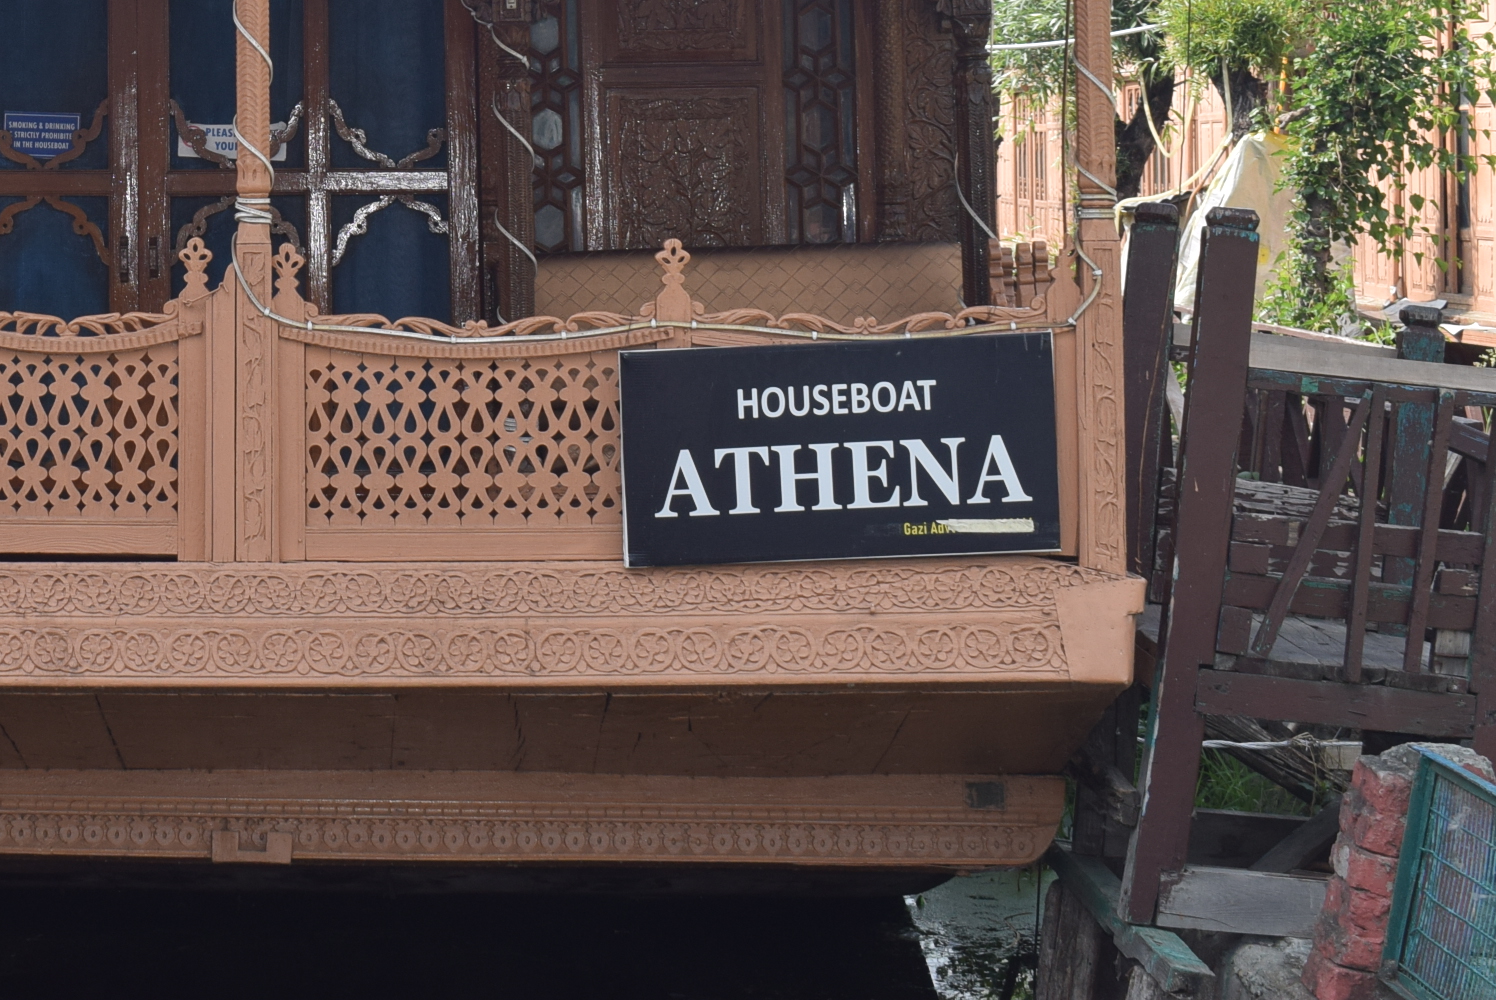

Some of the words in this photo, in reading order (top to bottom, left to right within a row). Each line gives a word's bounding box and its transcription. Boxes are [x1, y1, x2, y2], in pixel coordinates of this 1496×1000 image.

[8, 121, 38, 130] SMOKING
[45, 123, 76, 131] DRINKING
[14, 130, 40, 139] STRICTLY
[41, 132, 73, 140] PROHIBITE
[205, 127, 236, 138] PLEAS
[13, 140, 21, 148] IN
[22, 141, 33, 149] THE
[34, 141, 70, 150] HOUSEBOAT
[736, 379, 937, 420] HOUSEBOAT
[654, 434, 1033, 518] ATHENA
[903, 521, 928, 535] Gazi
